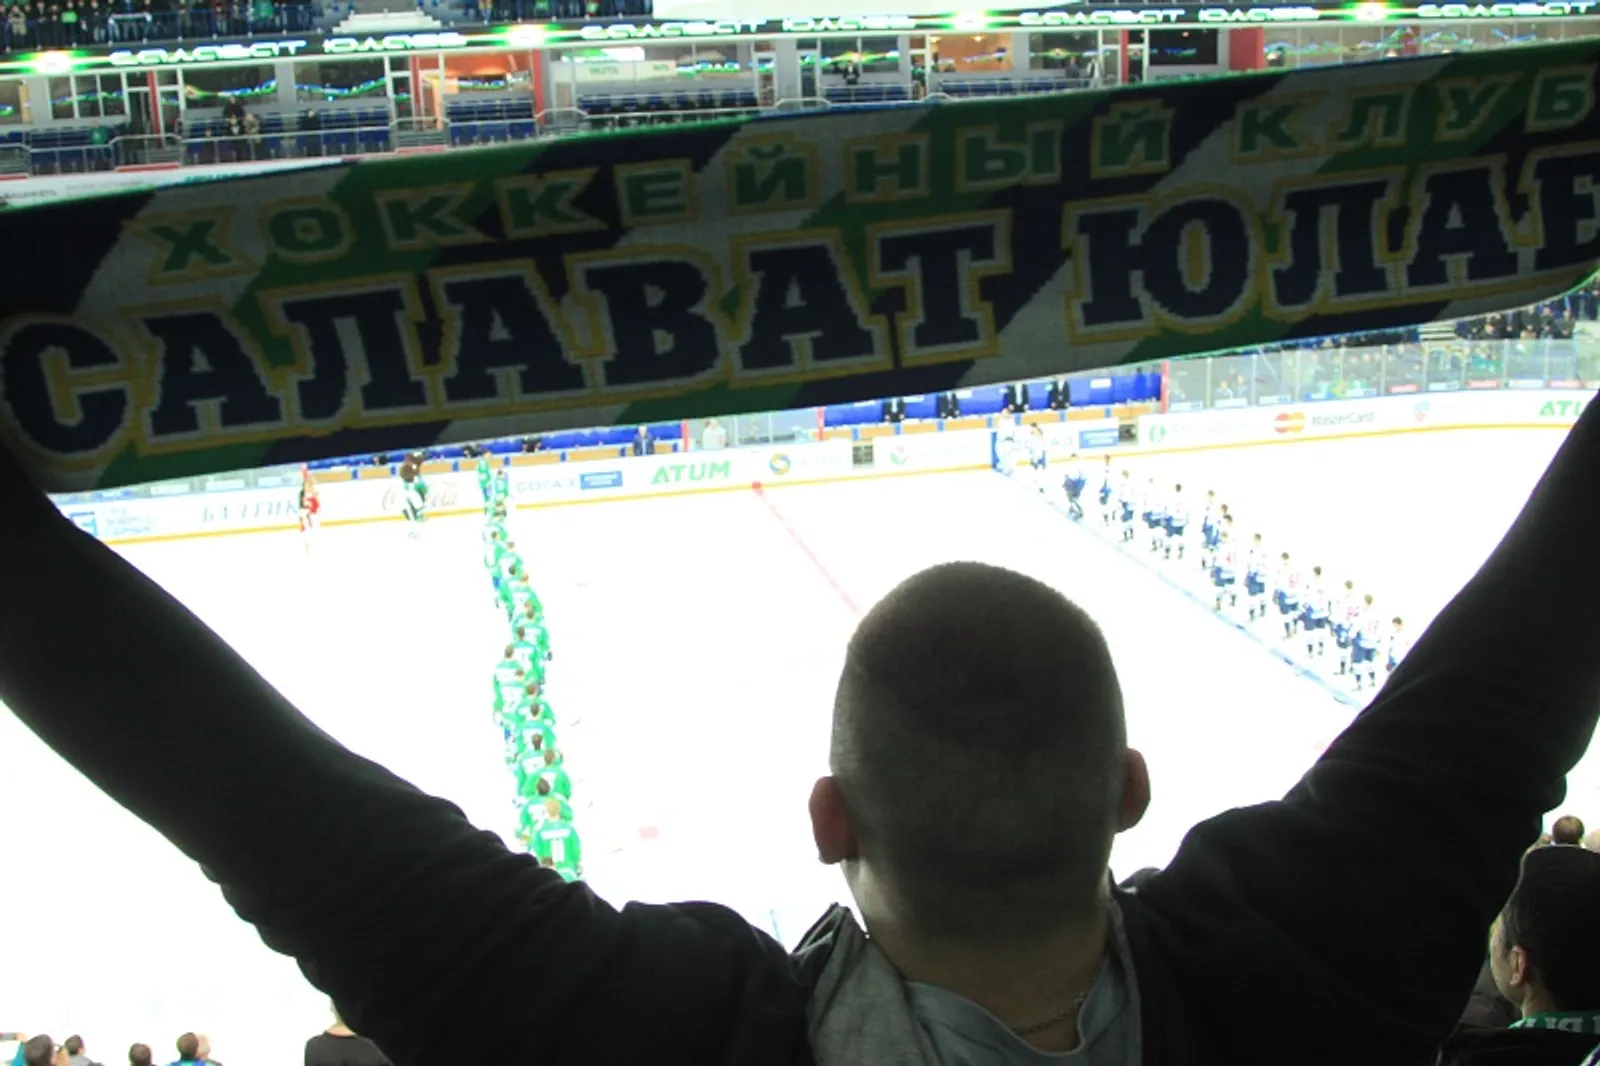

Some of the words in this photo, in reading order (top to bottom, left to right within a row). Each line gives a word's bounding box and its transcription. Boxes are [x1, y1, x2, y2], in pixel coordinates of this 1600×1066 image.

[146, 108, 1171, 274] ХОККЕЙНЫЙ
[1234, 68, 1592, 155] КЛУБ
[1, 214, 1006, 458] САЛАВАТ
[651, 461, 731, 485] ATUM
